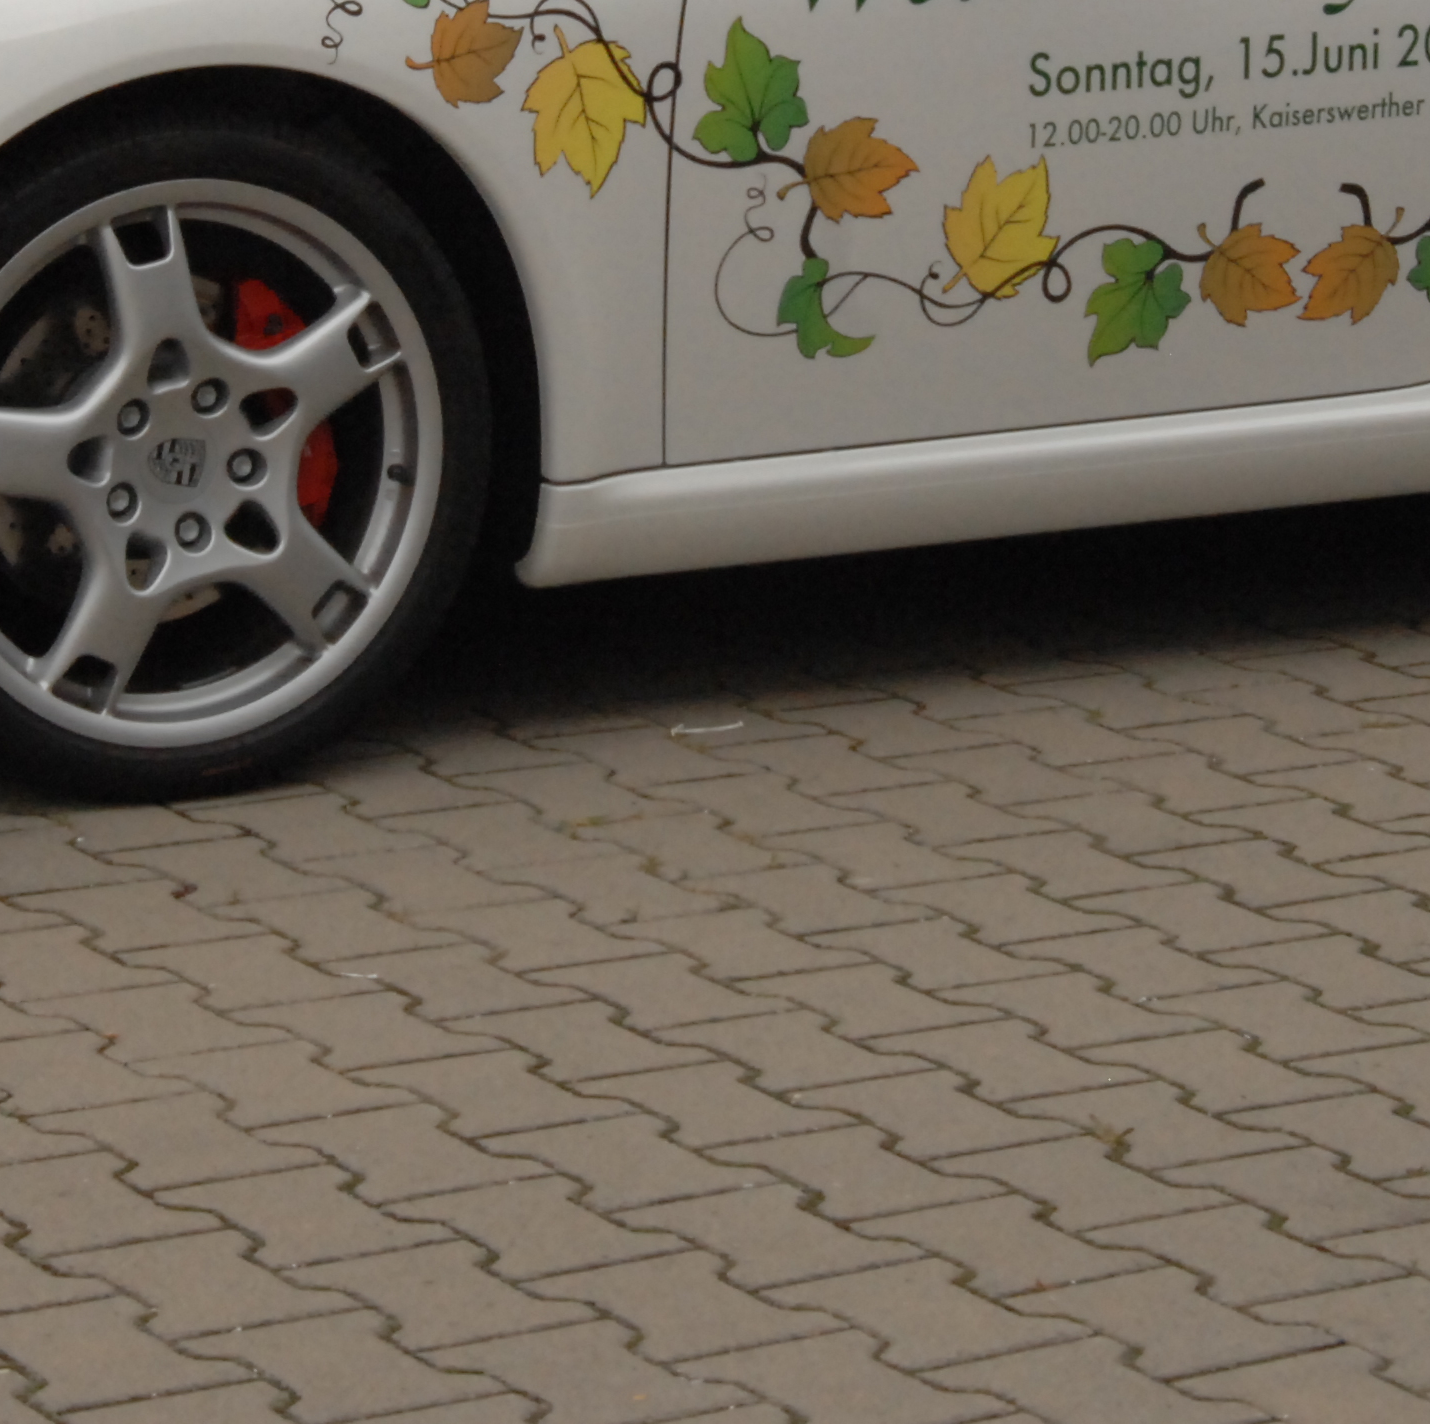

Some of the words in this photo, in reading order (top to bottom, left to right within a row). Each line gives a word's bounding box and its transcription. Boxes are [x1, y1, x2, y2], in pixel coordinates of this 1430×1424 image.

[1028, 50, 1215, 100] Sonntag,
[1028, 110, 1183, 149] 12.00-20.00
[1191, 105, 1242, 136] Uhr,
[1251, 91, 1426, 130] Kaiserswerther
